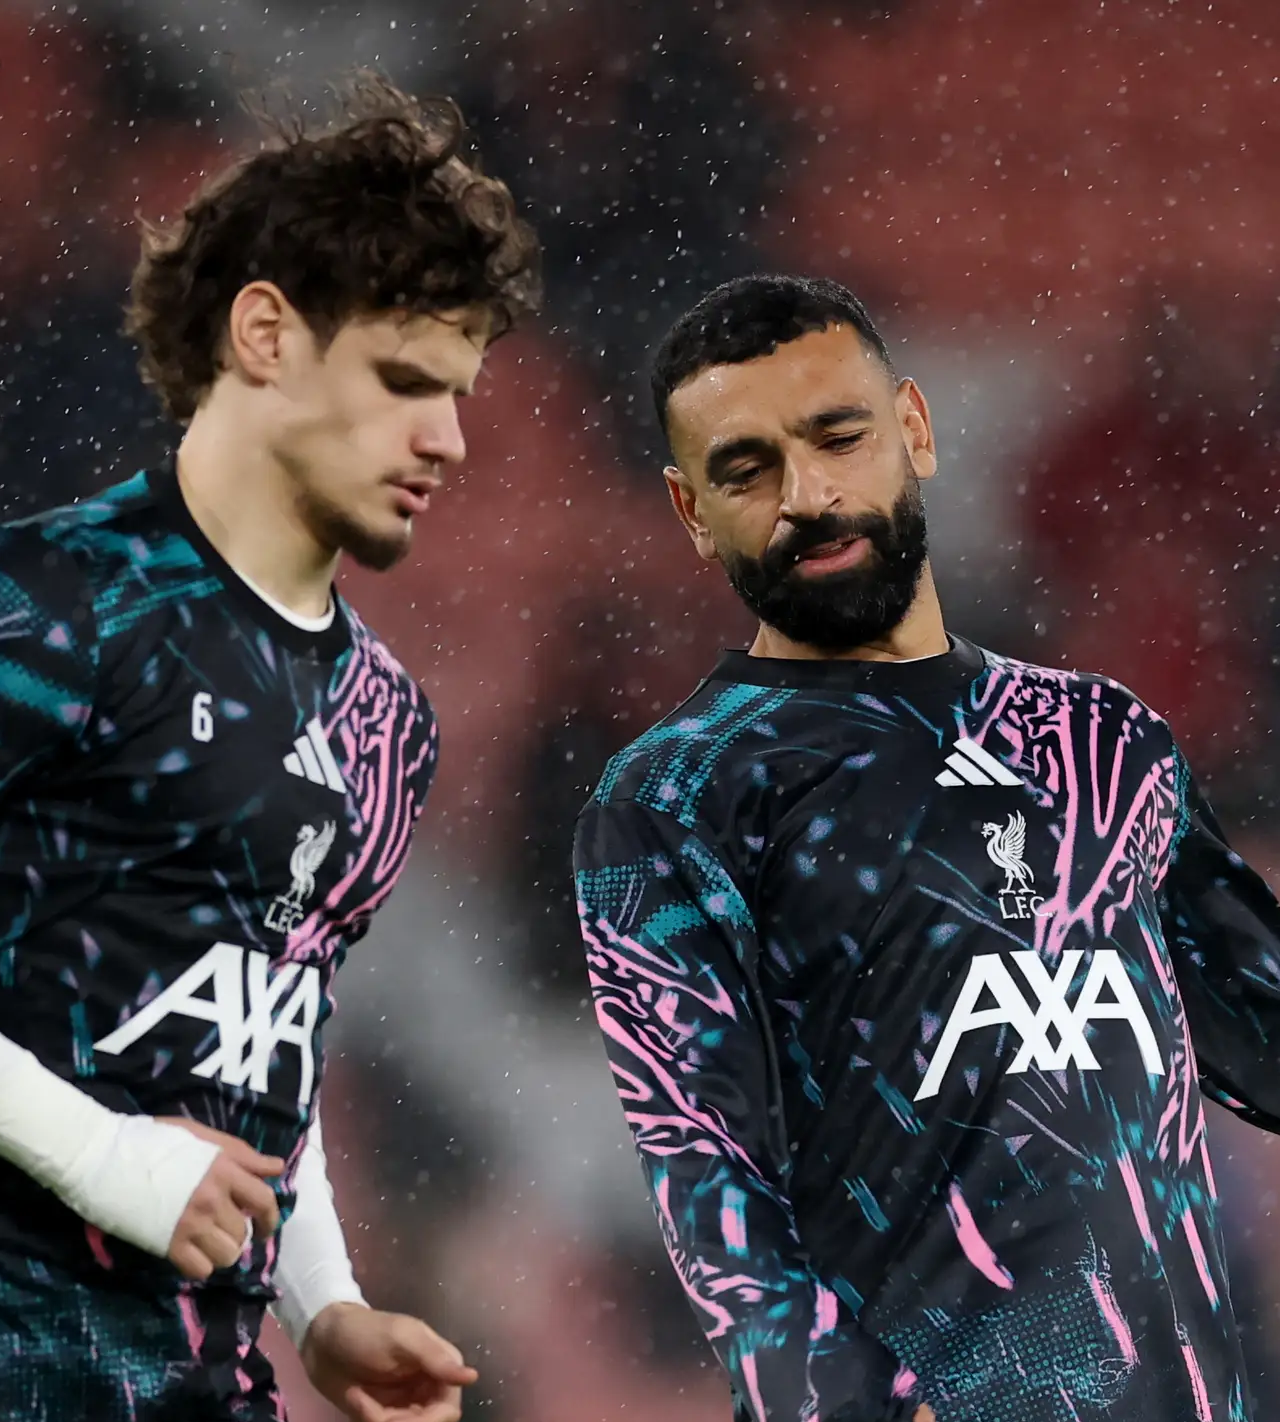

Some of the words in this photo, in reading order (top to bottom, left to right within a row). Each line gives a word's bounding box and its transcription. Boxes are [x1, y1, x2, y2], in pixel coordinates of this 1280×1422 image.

[191, 691, 214, 742] 6
[92, 941, 320, 1105] AXA
[913, 948, 1166, 1102] AXA
